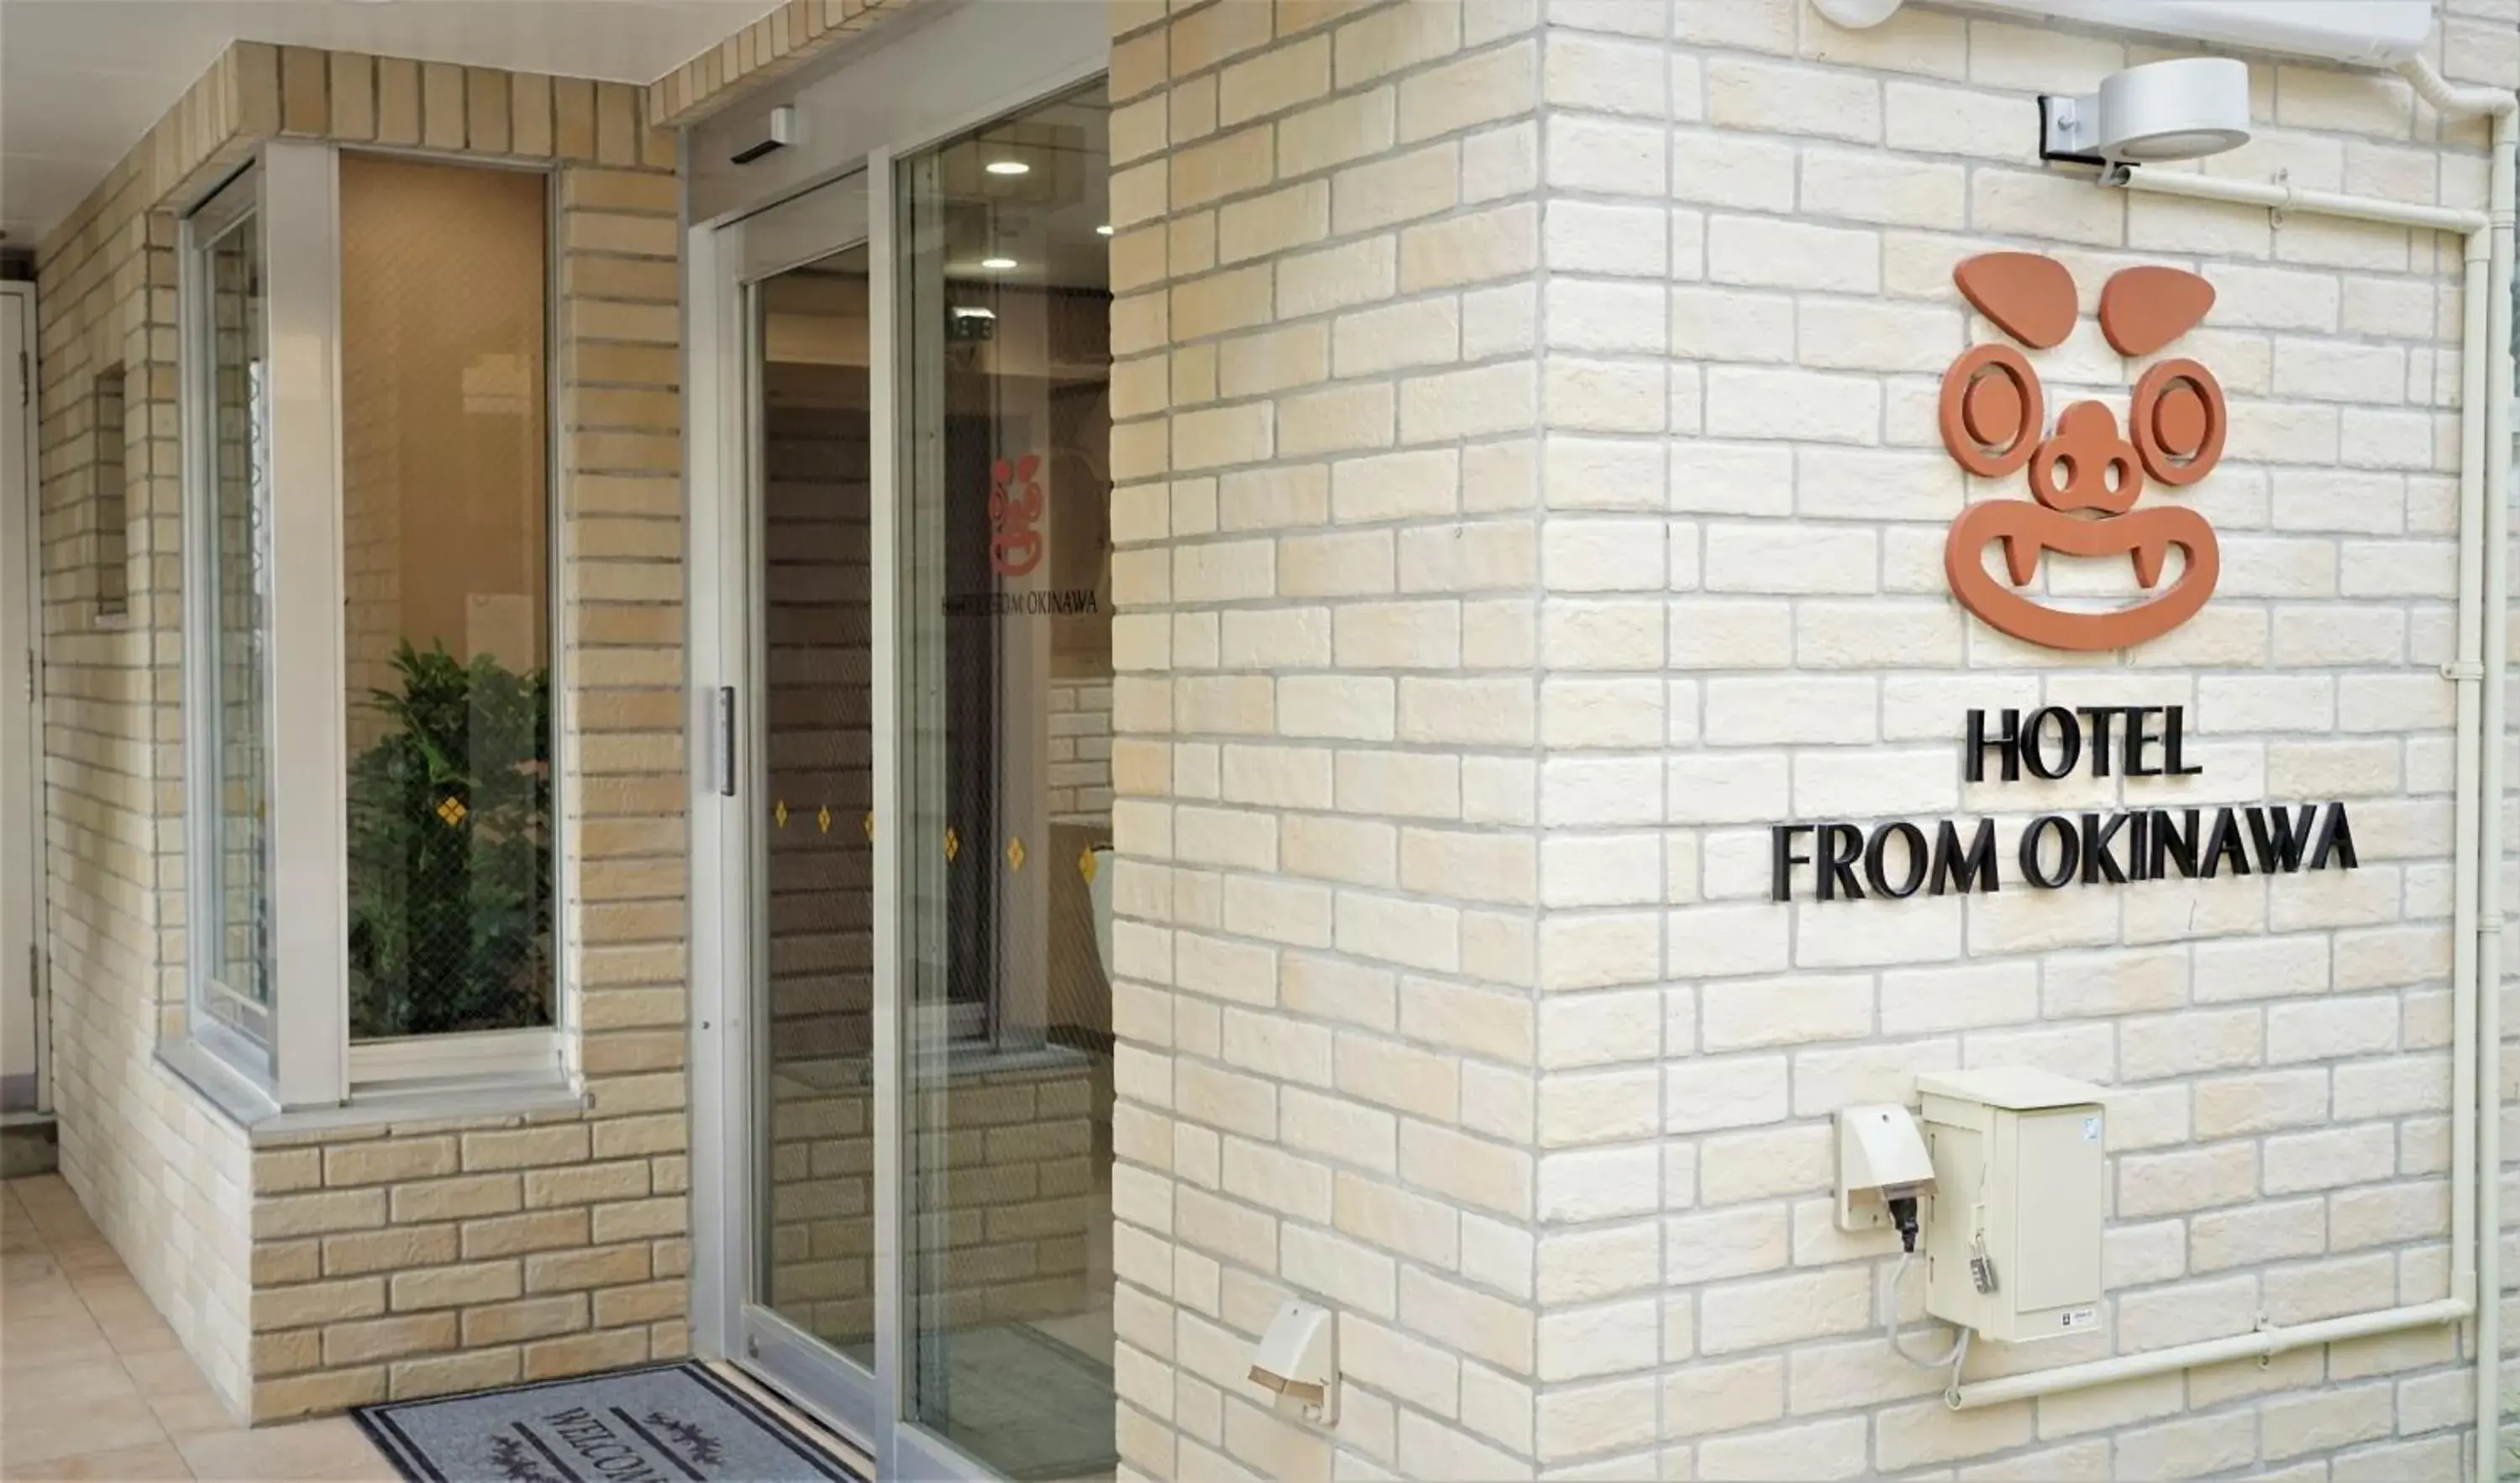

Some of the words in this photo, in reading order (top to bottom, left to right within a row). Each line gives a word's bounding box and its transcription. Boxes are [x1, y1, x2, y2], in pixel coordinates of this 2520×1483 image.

[1026, 590, 1098, 616] OKINAWA
[1966, 705, 2202, 782] HOTEL
[1772, 817, 1999, 901] FROM
[2019, 802, 2359, 889] OKINAWA
